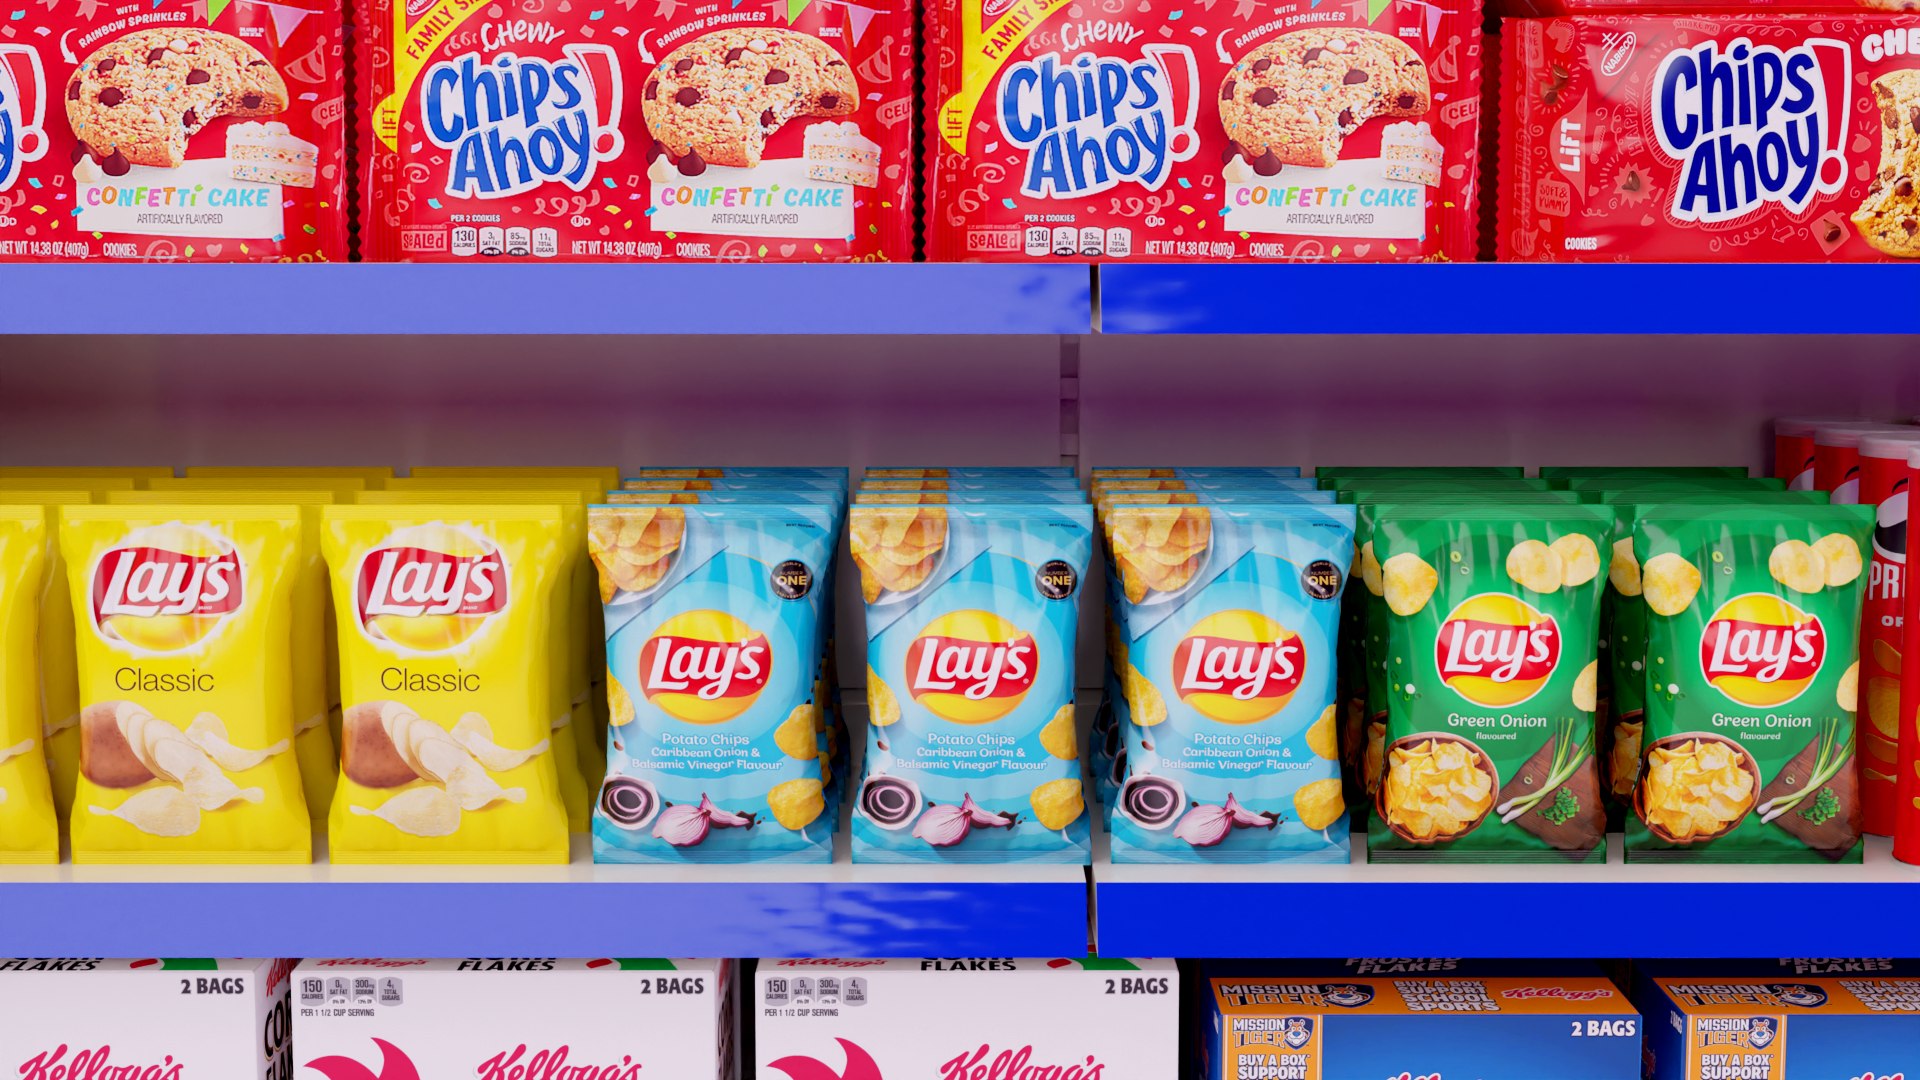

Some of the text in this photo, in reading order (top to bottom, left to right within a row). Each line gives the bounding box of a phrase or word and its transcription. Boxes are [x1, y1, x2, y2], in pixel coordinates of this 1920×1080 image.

[116, 4, 139, 16] WITH
[695, 4, 718, 16] WITH
[1274, 4, 1297, 16] WITH
[78, 11, 187, 48] RAINBOW SPRINKLES
[406, 6, 454, 60] FAMILY
[656, 11, 766, 48] RAINBOW SPRINKLES
[982, 6, 1034, 60] FAMILY
[1234, 11, 1346, 48] RAINBOW SPRINKLES
[1604, 35, 1634, 73] NABISCO
[426, 56, 582, 143] Chips
[1003, 56, 1159, 143] Chips
[1661, 44, 1815, 150] Chips
[946, 106, 962, 139] LIFT
[208, 188, 270, 207] CAKE
[784, 188, 844, 207] CAKE
[1360, 188, 1418, 207] CAKE
[1540, 184, 1559, 197] SOFT
[1539, 196, 1568, 212] YUMMY
[137, 213, 224, 225] ARTIFICIALLY FLAVORED
[450, 214, 464, 222] PER
[472, 214, 500, 222] COOKIES
[711, 213, 799, 224] ARTIFICIALLY FLAVORED
[1024, 214, 1038, 222] PER
[1046, 214, 1075, 222] COOKIES
[1286, 213, 1374, 224] ARTIFICIALLY FLAVORED
[455, 230, 475, 242] 130
[1029, 230, 1048, 242] 130
[14, 241, 28, 255] WT
[30, 241, 51, 255] 14.38
[52, 242, 63, 256] OZ
[64, 242, 89, 259] (407g)
[103, 242, 137, 257] COOKIES
[572, 240, 662, 259] NET WT 14.38 OZ (407g)
[676, 242, 710, 256] COOKIES
[1145, 241, 1235, 259] NET WT 14.38 OZ (407g)
[1250, 242, 1284, 256] COOKIES
[1565, 237, 1597, 250] COOKIES
[100, 552, 236, 616] Lay's
[366, 552, 498, 616] Lay's
[776, 575, 807, 586] ONE
[1041, 575, 1072, 586] ONE
[1308, 575, 1337, 586] ONE
[1444, 620, 1552, 682] Lay's
[1708, 620, 1818, 682] Lay's
[647, 637, 765, 700] Lay's
[914, 637, 1030, 700] Lay's
[1181, 637, 1298, 700] Lay's
[115, 668, 214, 692] Classic
[380, 668, 480, 692] Classic
[1447, 714, 1547, 728] Green Onion
[1712, 714, 1812, 728] Green Onion
[662, 733, 750, 748] Potato Chips
[928, 733, 1015, 748] Potato Chips
[1194, 733, 1282, 748] Potato Chips
[1476, 732, 1517, 741] flavoured
[1740, 732, 1781, 740] flavoured
[651, 747, 761, 758] Caribbean Onion &
[916, 747, 1026, 758] Caribbean Onion &
[1182, 747, 1292, 758] Caribbean Onion &
[632, 759, 783, 772] Balsamic Vinegar Flavour
[897, 759, 1047, 772] Balsamic Vinegar Flavour
[1162, 759, 1314, 772] Balsamic Vinegar Flavour
[0, 961, 101, 970] FLAKES
[457, 961, 555, 970] FLAKES
[920, 961, 1016, 971] FLAKES
[181, 978, 244, 994] 2 BAGS
[303, 980, 322, 992] 150
[641, 978, 704, 994] 2 BAGS
[768, 980, 787, 992] 150
[1105, 978, 1169, 994] 2 BAGS
[1220, 984, 1321, 994] MISSION
[1668, 984, 1772, 994] MISSION
[1223, 994, 1330, 1007] TIGER
[1401, 994, 1495, 1002] SCHOOL
[1501, 987, 1613, 1000] Kellogg's
[1676, 994, 1788, 1007] TIGER
[1406, 1002, 1500, 1011] SPORTS
[1233, 1018, 1285, 1031] MISSION
[1571, 1020, 1636, 1037] 2 BAGS
[1697, 1018, 1749, 1031] MISSION
[1233, 1031, 1285, 1048] TIGER
[1697, 1031, 1750, 1048] TIGER
[1238, 1054, 1266, 1066] BUY
[1268, 1054, 1278, 1066] A
[1701, 1054, 1728, 1066] BUY
[1731, 1054, 1741, 1066] A
[1238, 1066, 1307, 1080] SUPPORT
[1701, 1066, 1770, 1080] SUPPORT
